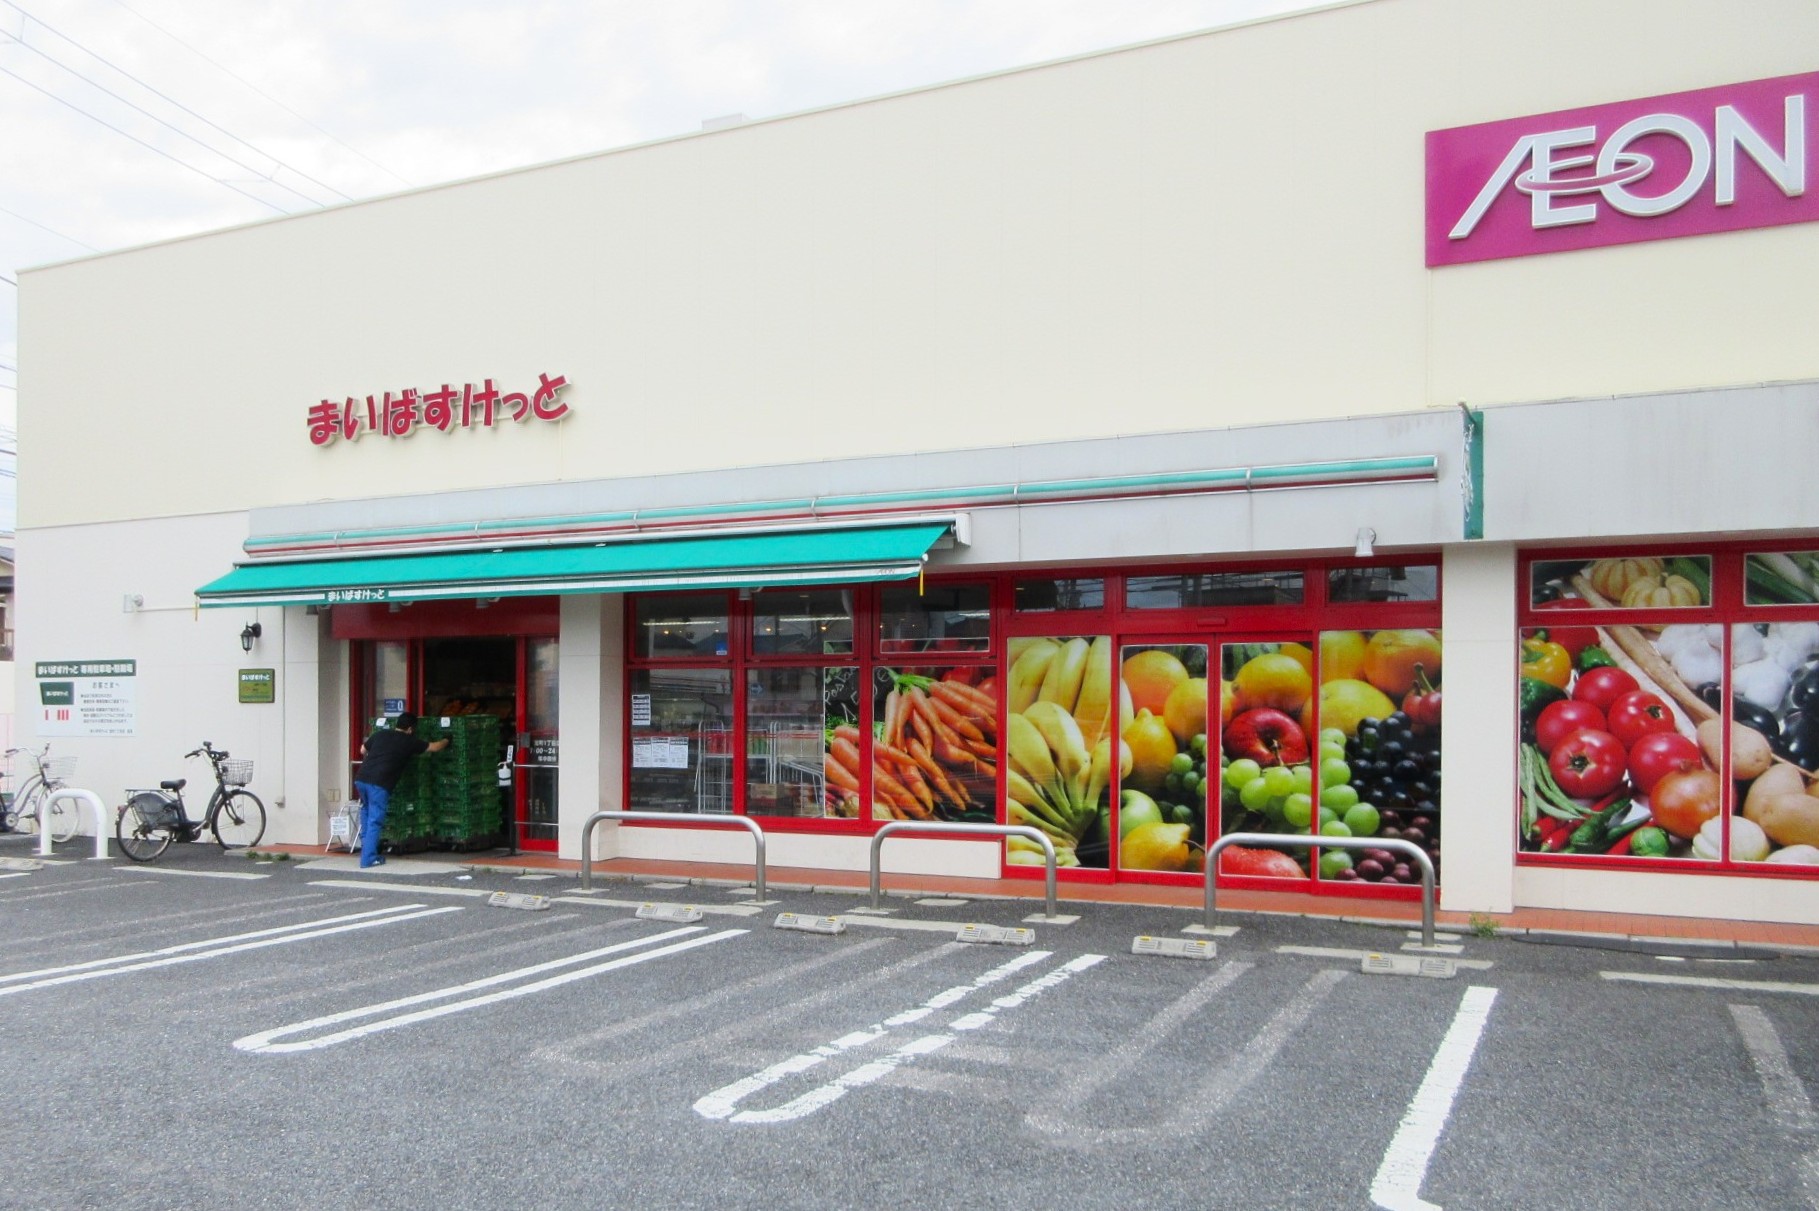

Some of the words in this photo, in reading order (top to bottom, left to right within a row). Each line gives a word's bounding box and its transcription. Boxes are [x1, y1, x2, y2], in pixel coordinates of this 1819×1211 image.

[306, 372, 571, 446] まいばすけっと
[327, 589, 385, 602] まいばすけっと
